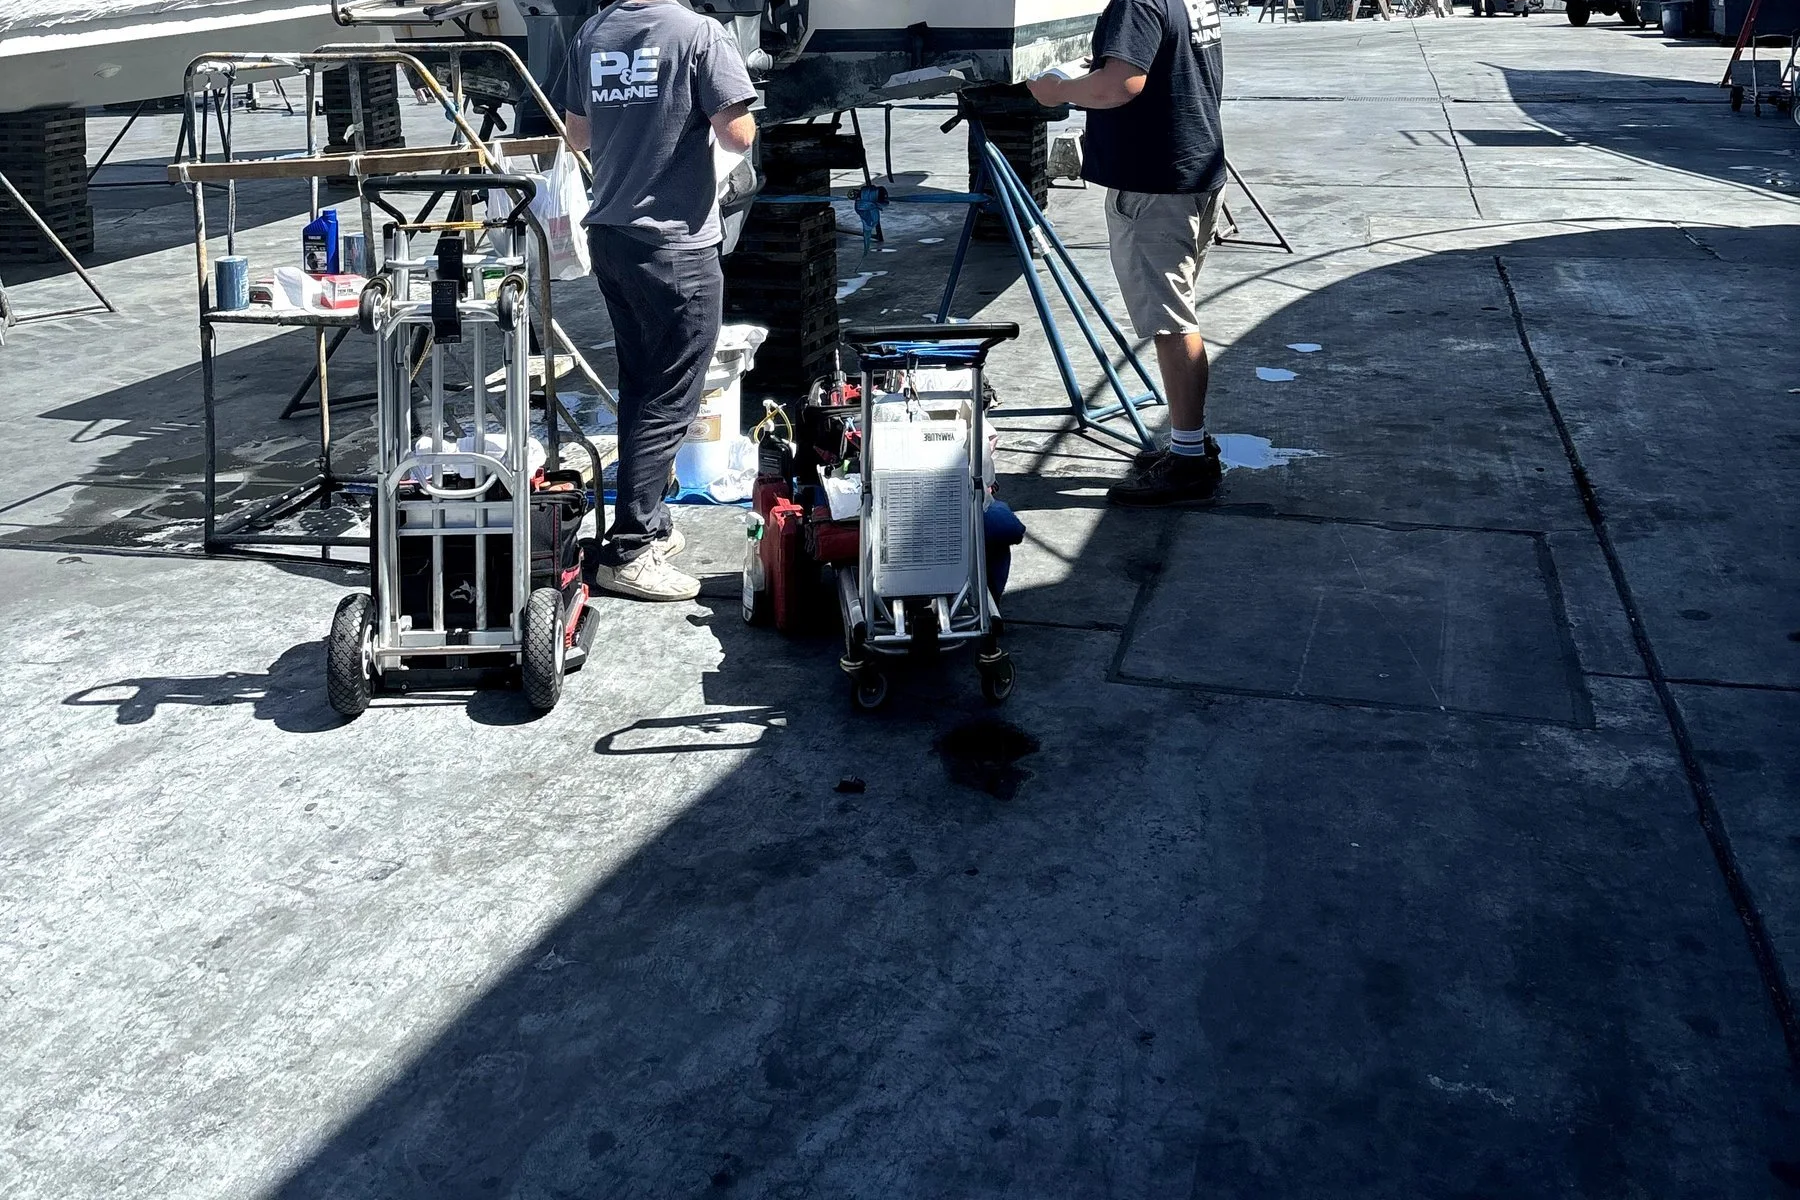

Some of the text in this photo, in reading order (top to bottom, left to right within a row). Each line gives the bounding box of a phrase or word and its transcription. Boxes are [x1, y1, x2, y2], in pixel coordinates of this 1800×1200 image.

[590, 46, 661, 87] P&E
[591, 85, 659, 103] MARNE
[923, 432, 955, 441] YAMALUBE
